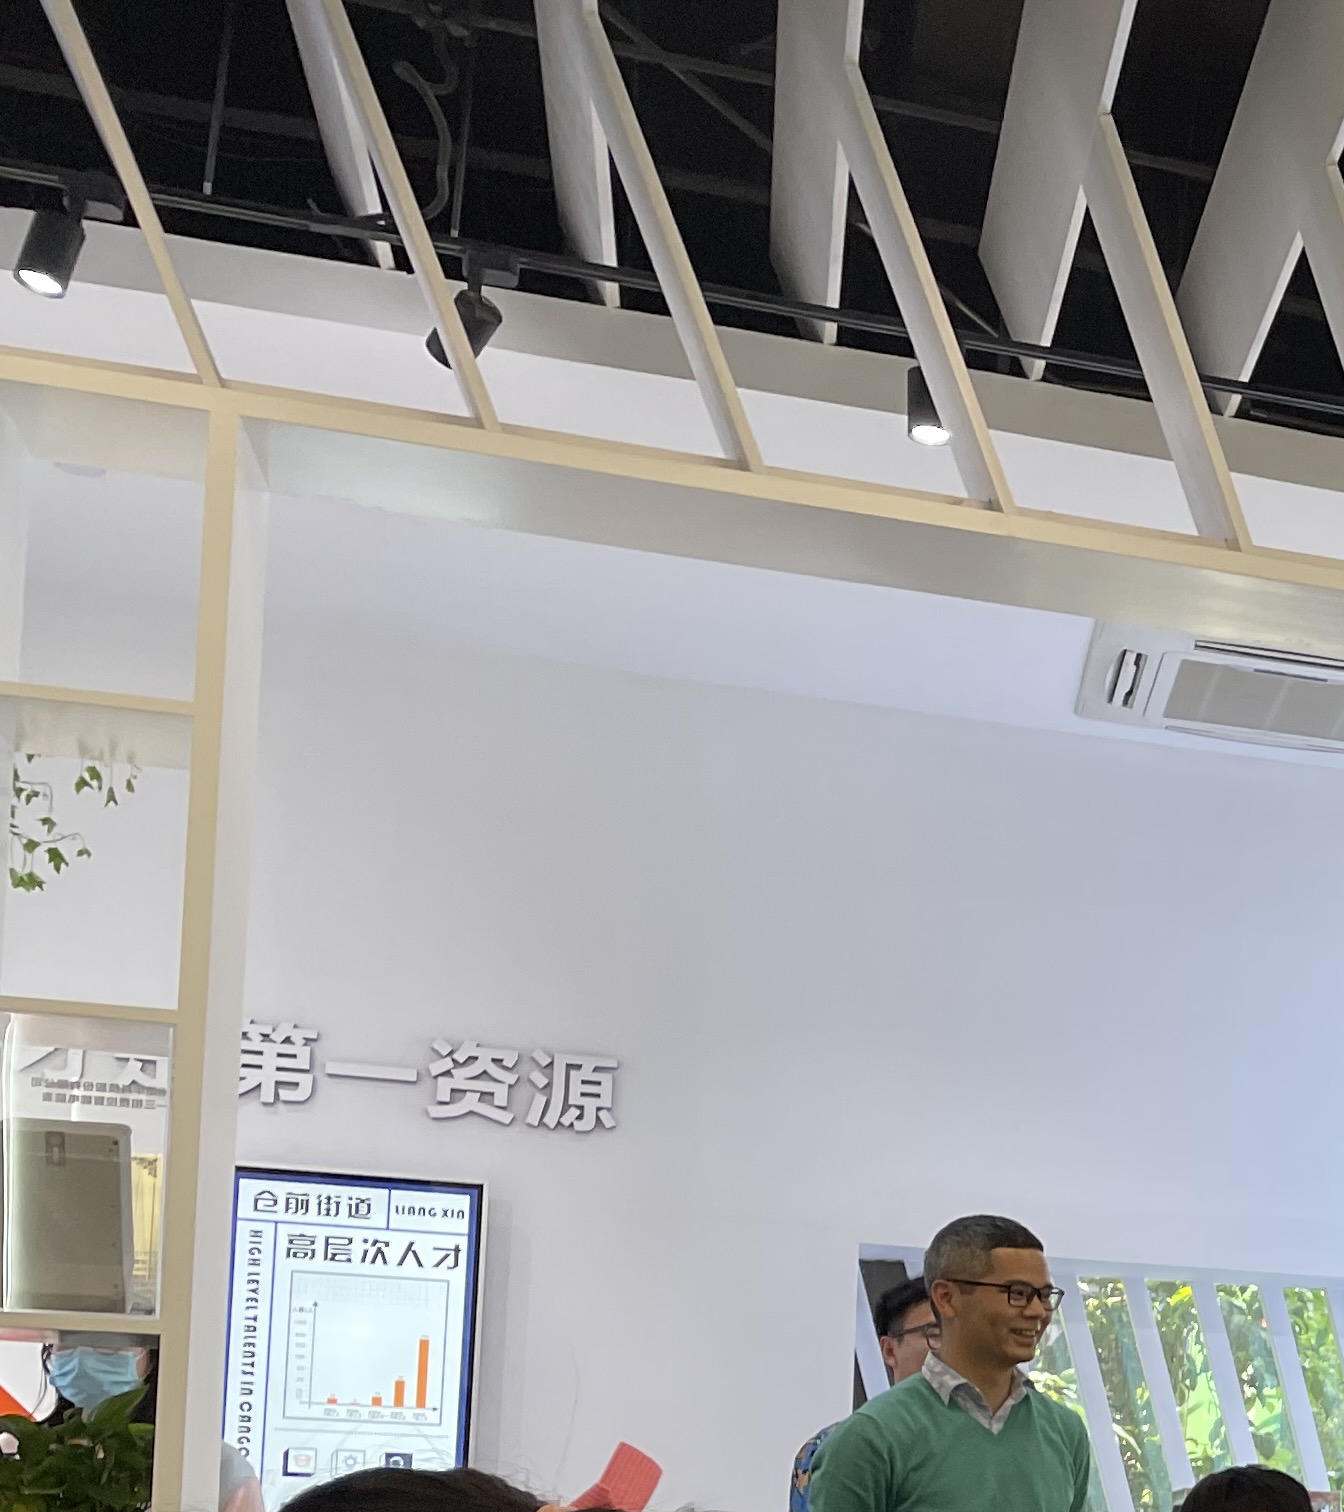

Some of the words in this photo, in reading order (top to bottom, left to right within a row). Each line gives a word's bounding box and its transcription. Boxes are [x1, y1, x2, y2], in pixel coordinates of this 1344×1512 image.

[238, 1018, 618, 1133] 第一资源
[247, 1229, 263, 1267] HIGH
[286, 1233, 463, 1271] 高层次人才
[244, 1272, 261, 1311] LEVEL
[241, 1315, 258, 1376] TALENTS
